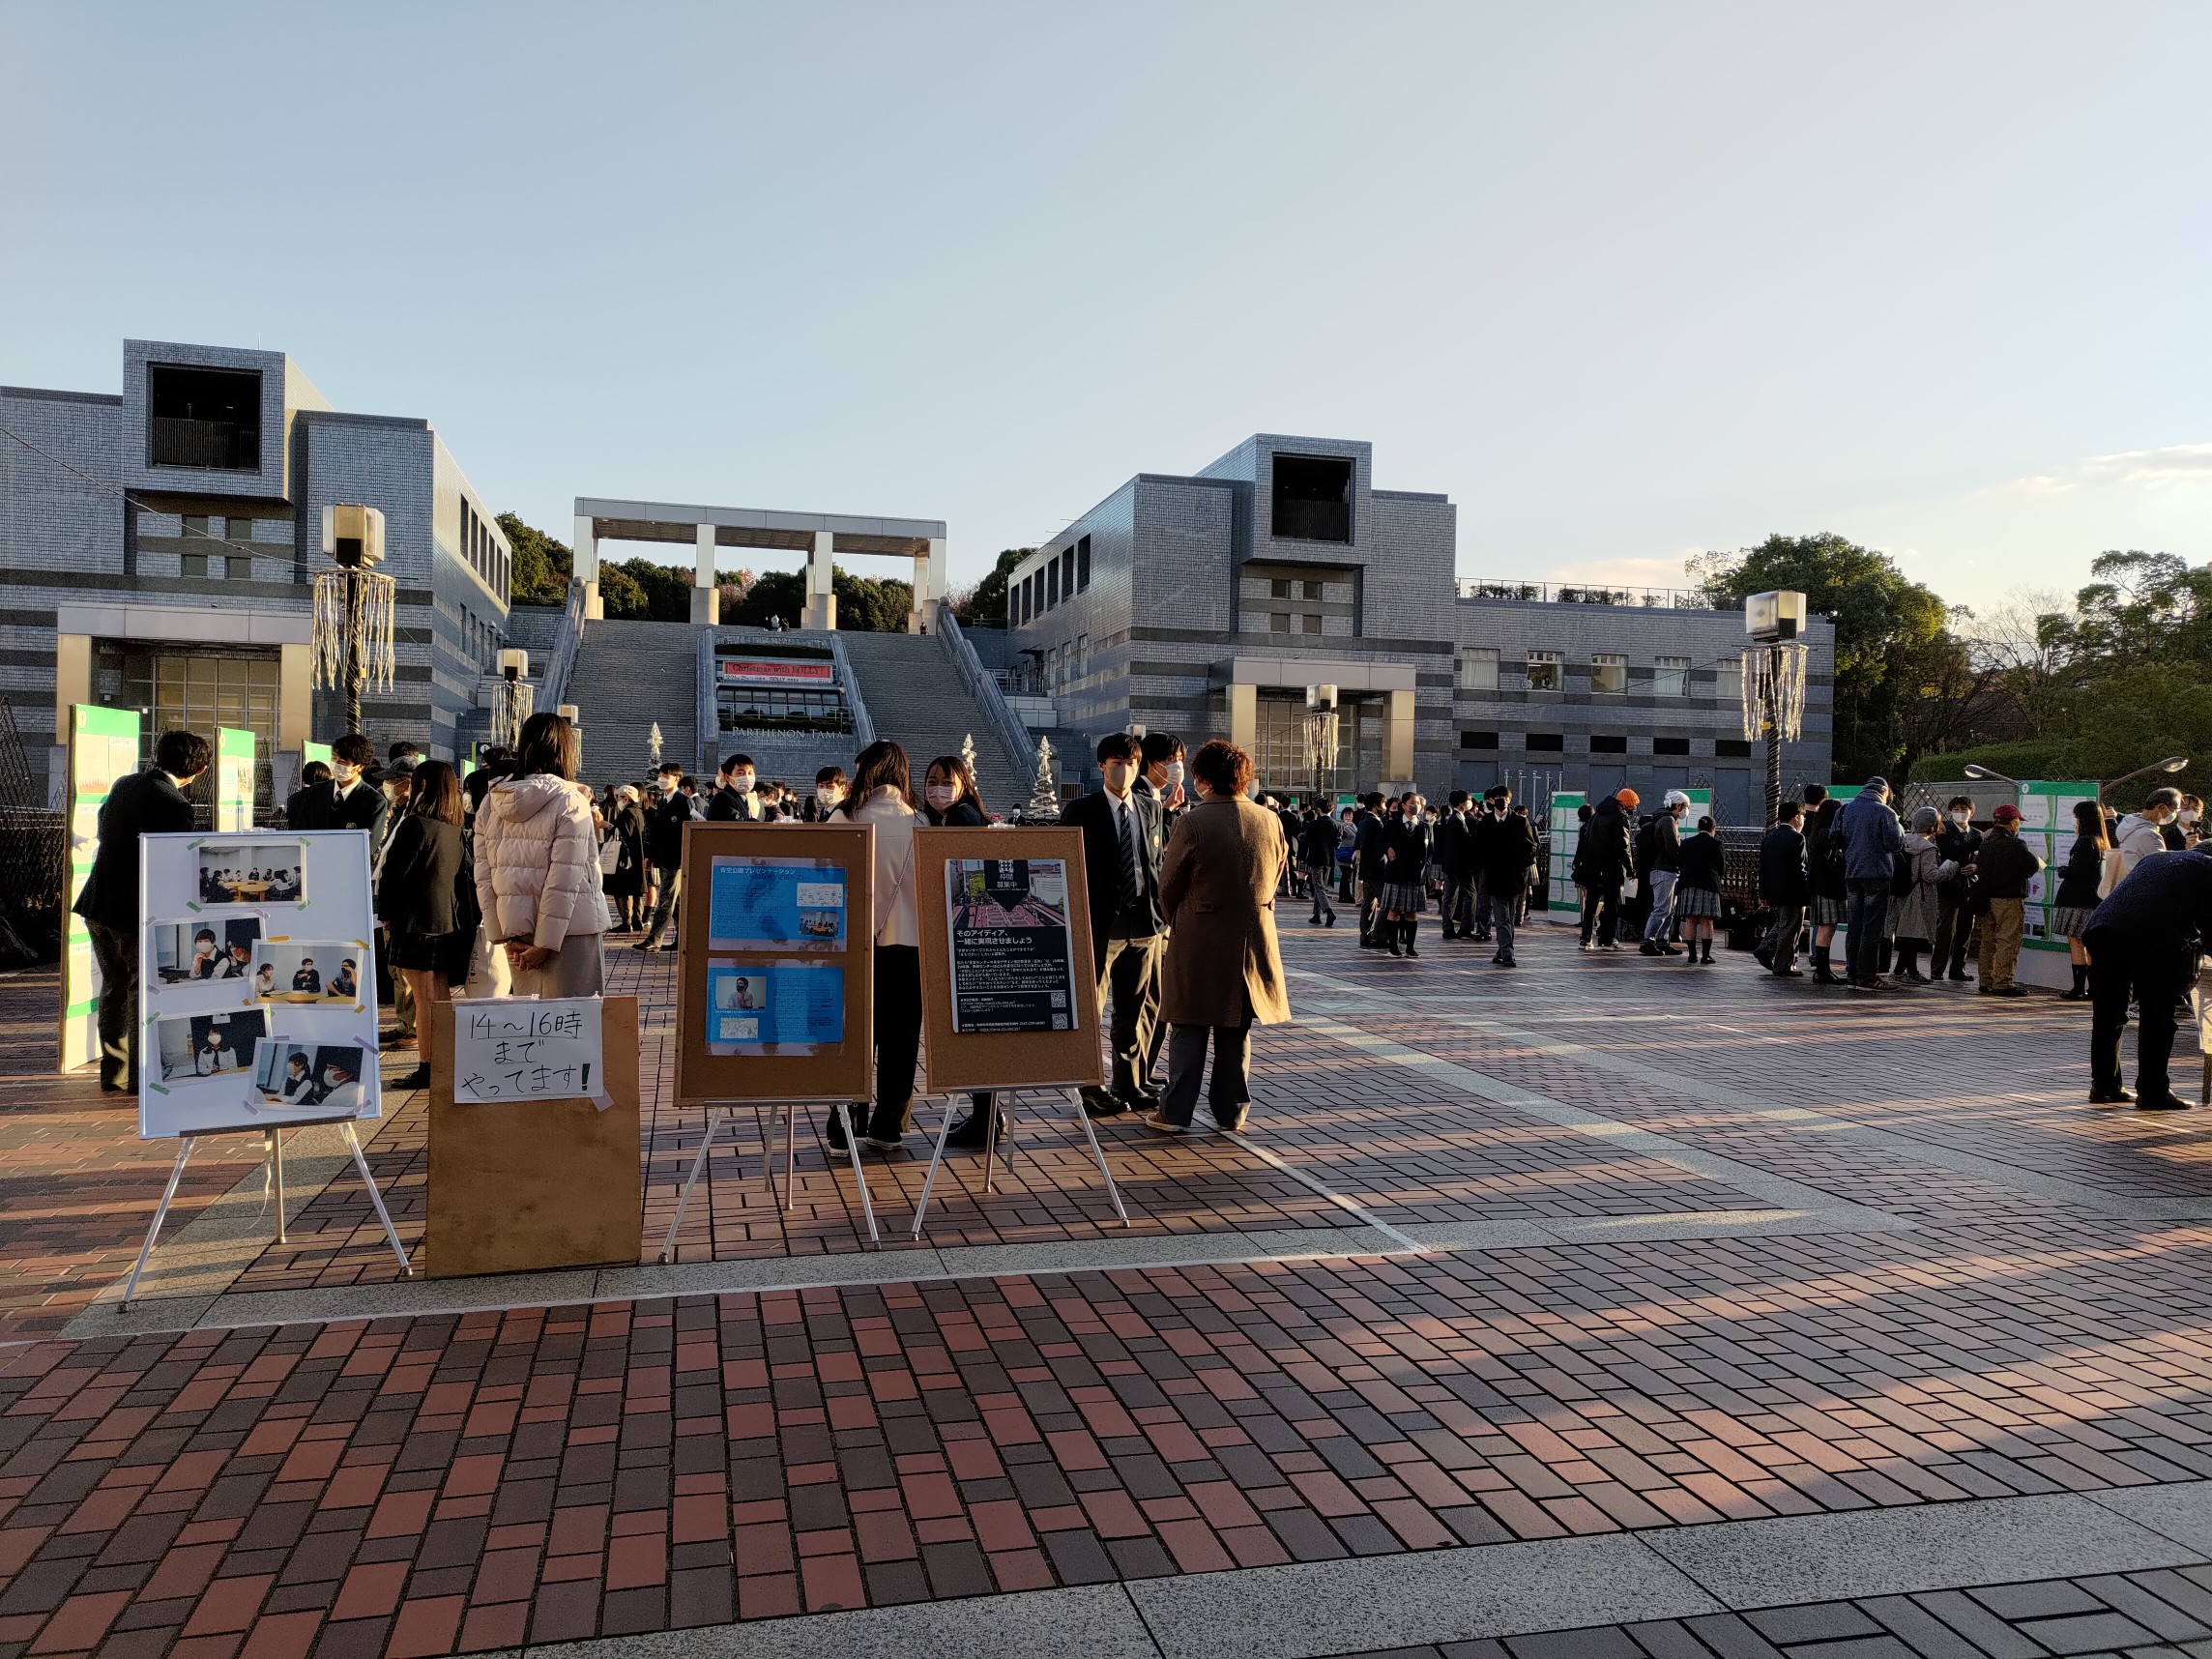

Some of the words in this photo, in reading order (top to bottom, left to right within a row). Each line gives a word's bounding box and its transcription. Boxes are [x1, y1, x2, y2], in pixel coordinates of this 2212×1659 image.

[733, 663, 771, 674] Christmas
[773, 665, 790, 675] with
[732, 726, 805, 738] PARTHENON
[809, 729, 844, 740] TAMA
[956, 937, 1033, 946] 一緒に実現させましょう
[494, 1040, 544, 1063] まで
[461, 1062, 591, 1096] やってます!
